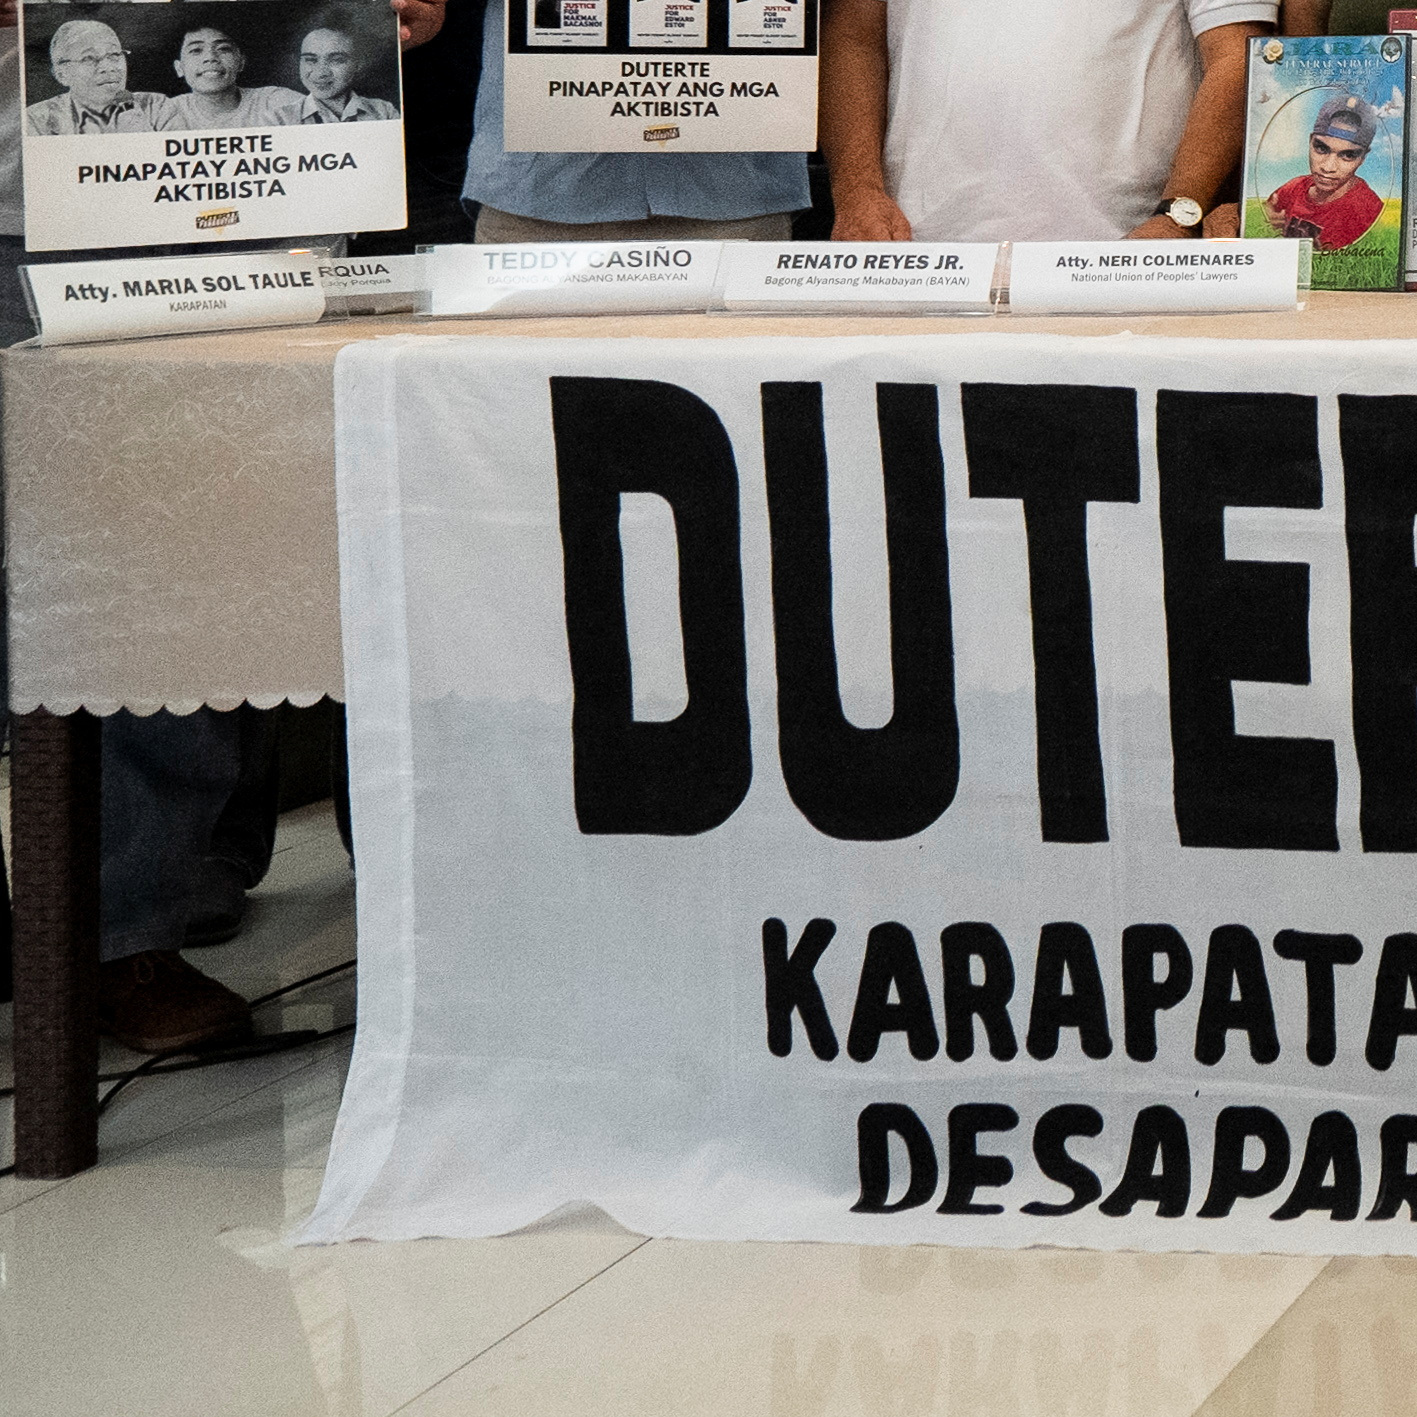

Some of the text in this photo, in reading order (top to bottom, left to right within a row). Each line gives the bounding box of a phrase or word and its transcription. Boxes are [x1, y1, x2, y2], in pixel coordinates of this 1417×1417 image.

[621, 62, 710, 77] DUTERTE
[550, 82, 779, 97] PINAPATAY ANG MGA
[610, 102, 720, 117] AKTIBISTA
[165, 135, 272, 157] DUTERTE
[78, 152, 357, 184] PINAPATAY ANG MGA
[154, 179, 286, 203] AKTIBISTA
[484, 246, 692, 270] TEDDY CASIÑO
[777, 254, 964, 269] RENATO REYES JR.
[1057, 255, 1255, 269] Atty. NERI COLMENARES
[543, 274, 613, 282] AYANSANG
[617, 273, 688, 281] MAKABAYAN
[765, 276, 970, 286] Bagong Alyansang Makabayan (BAYAN)
[1071, 273, 1112, 282] National
[1115, 273, 1142, 281] Union
[1145, 272, 1154, 281] of
[1200, 272, 1238, 281] Lawyers
[65, 272, 312, 303] Atty. MARIA SOL TAULE
[169, 300, 226, 312] KARAPATAN
